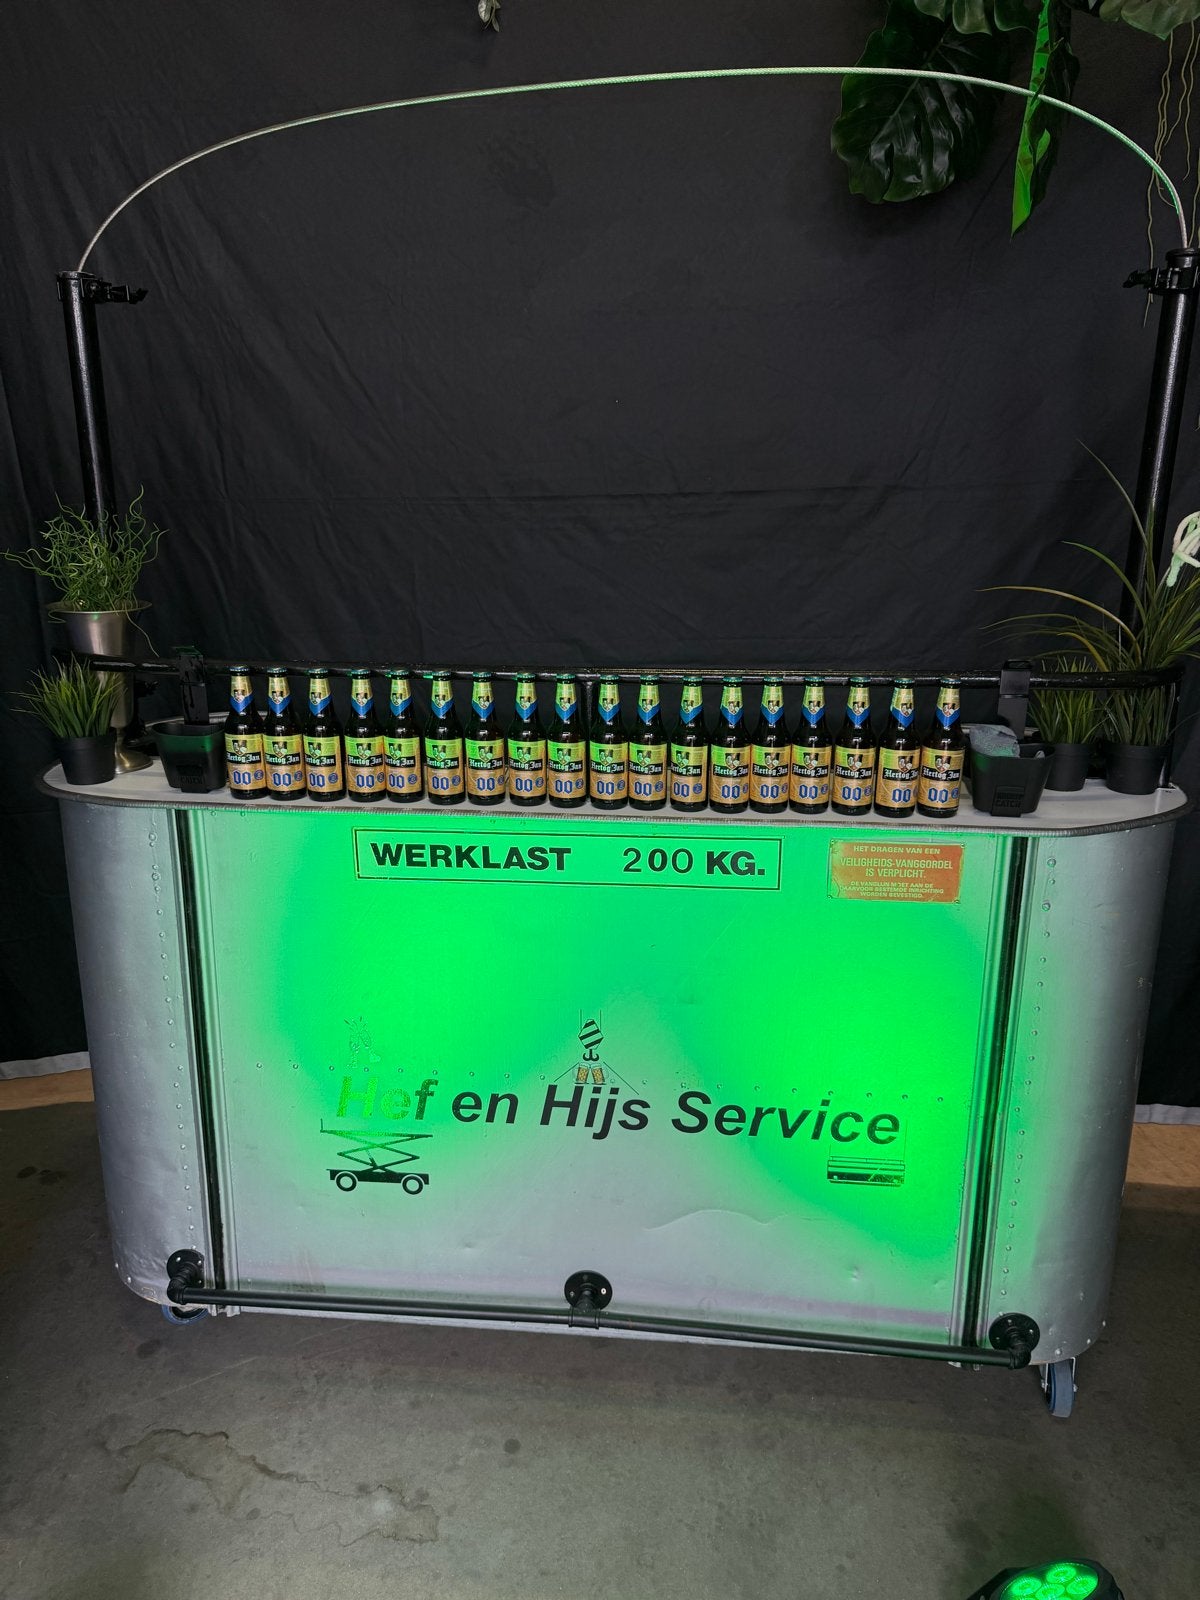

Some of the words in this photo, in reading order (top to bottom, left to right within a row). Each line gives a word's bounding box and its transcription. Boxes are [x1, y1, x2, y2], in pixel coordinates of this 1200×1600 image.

[246, 754, 260, 763] Jan
[287, 756, 299, 764] Jan
[305, 755, 320, 765] ertog
[321, 757, 334, 766] Jan
[370, 757, 382, 767] Jan
[401, 758, 414, 767] Jan
[445, 760, 458, 769] Jan
[492, 760, 502, 769] Jan
[529, 761, 541, 770] Jan
[569, 763, 582, 772] Jan
[611, 764, 624, 773] Jan
[649, 765, 662, 774] Jan
[687, 767, 700, 776] Jan
[738, 767, 748, 777] Jan
[777, 767, 788, 776] Jan
[816, 768, 828, 777] Jan
[860, 769, 872, 778] Jan
[947, 771, 960, 781] Jan
[370, 842, 571, 871] WERKLAST
[622, 847, 693, 874] 200
[706, 850, 766, 876] KG.
[866, 868, 874, 877] IS
[878, 869, 926, 878] VERPLICHT.
[336, 1076, 439, 1120] Hef
[452, 1091, 518, 1124] en
[540, 1084, 651, 1140] Hijs
[672, 1090, 900, 1144] Service
